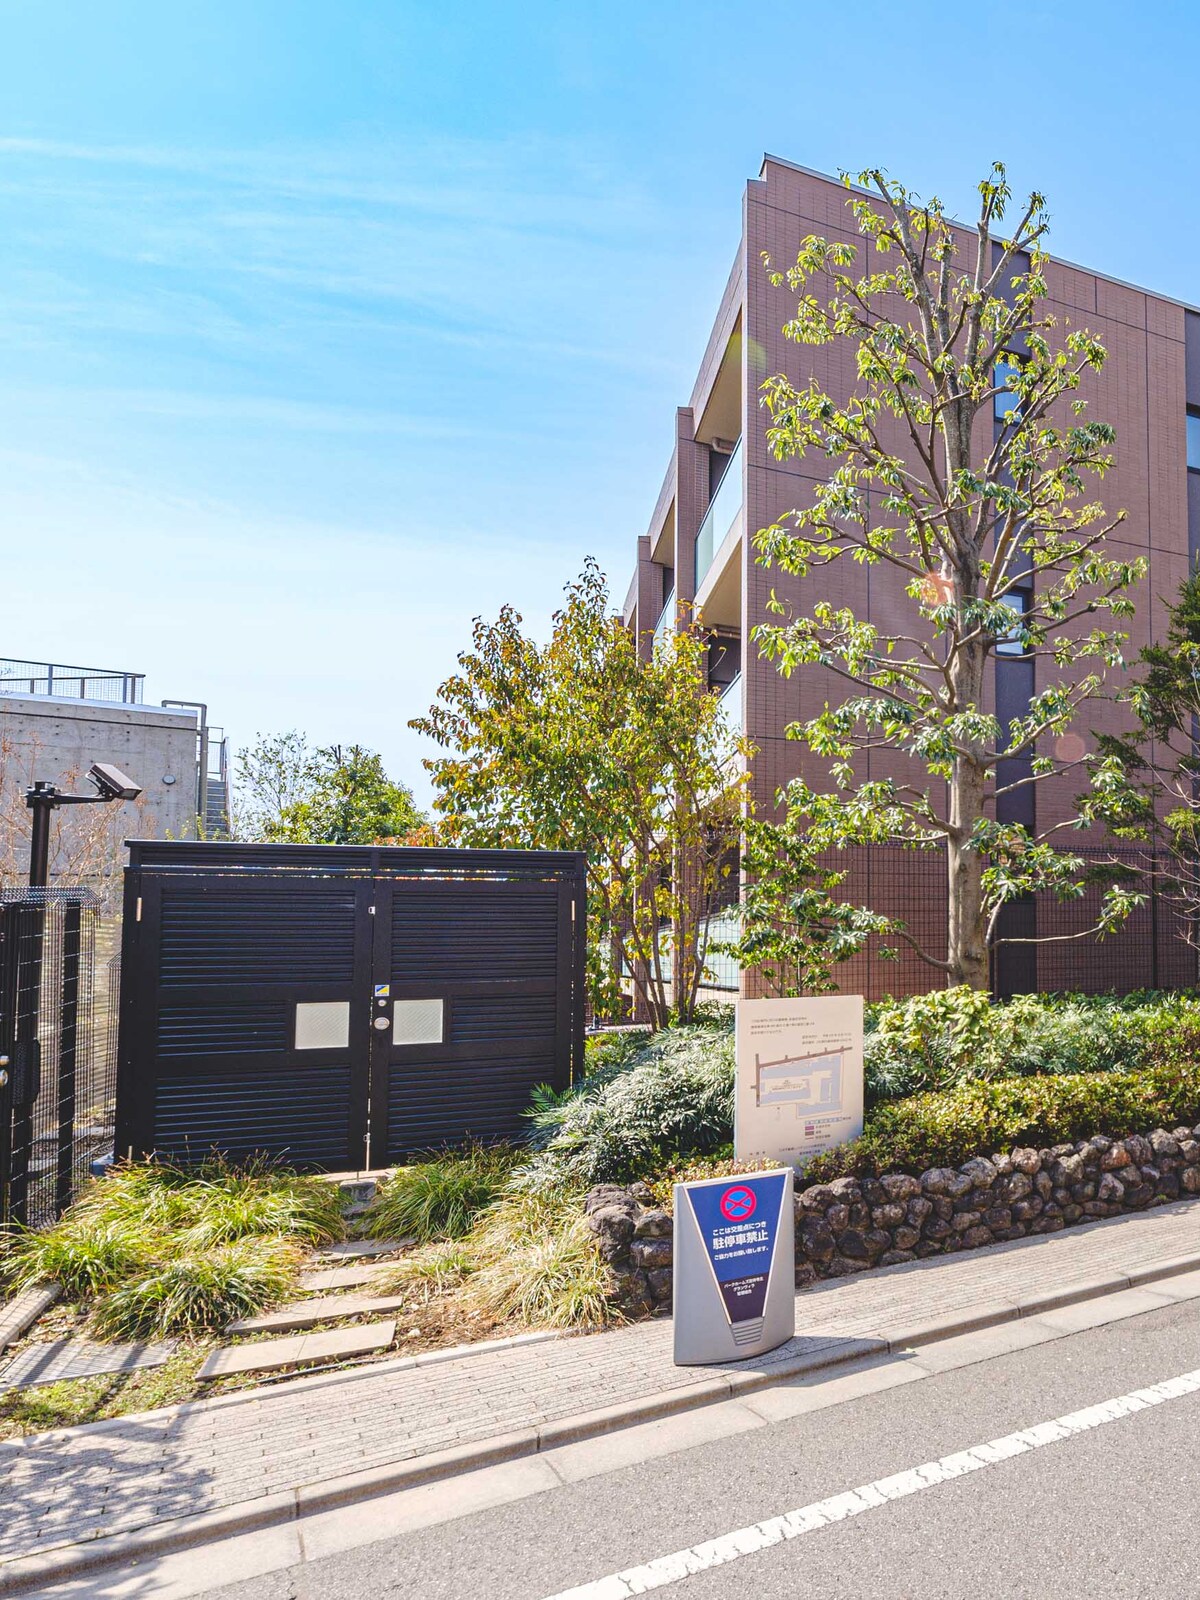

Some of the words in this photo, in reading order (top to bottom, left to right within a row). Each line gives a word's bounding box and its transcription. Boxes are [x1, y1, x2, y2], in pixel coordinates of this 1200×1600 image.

[713, 1229, 769, 1250] 駐停車禁止
